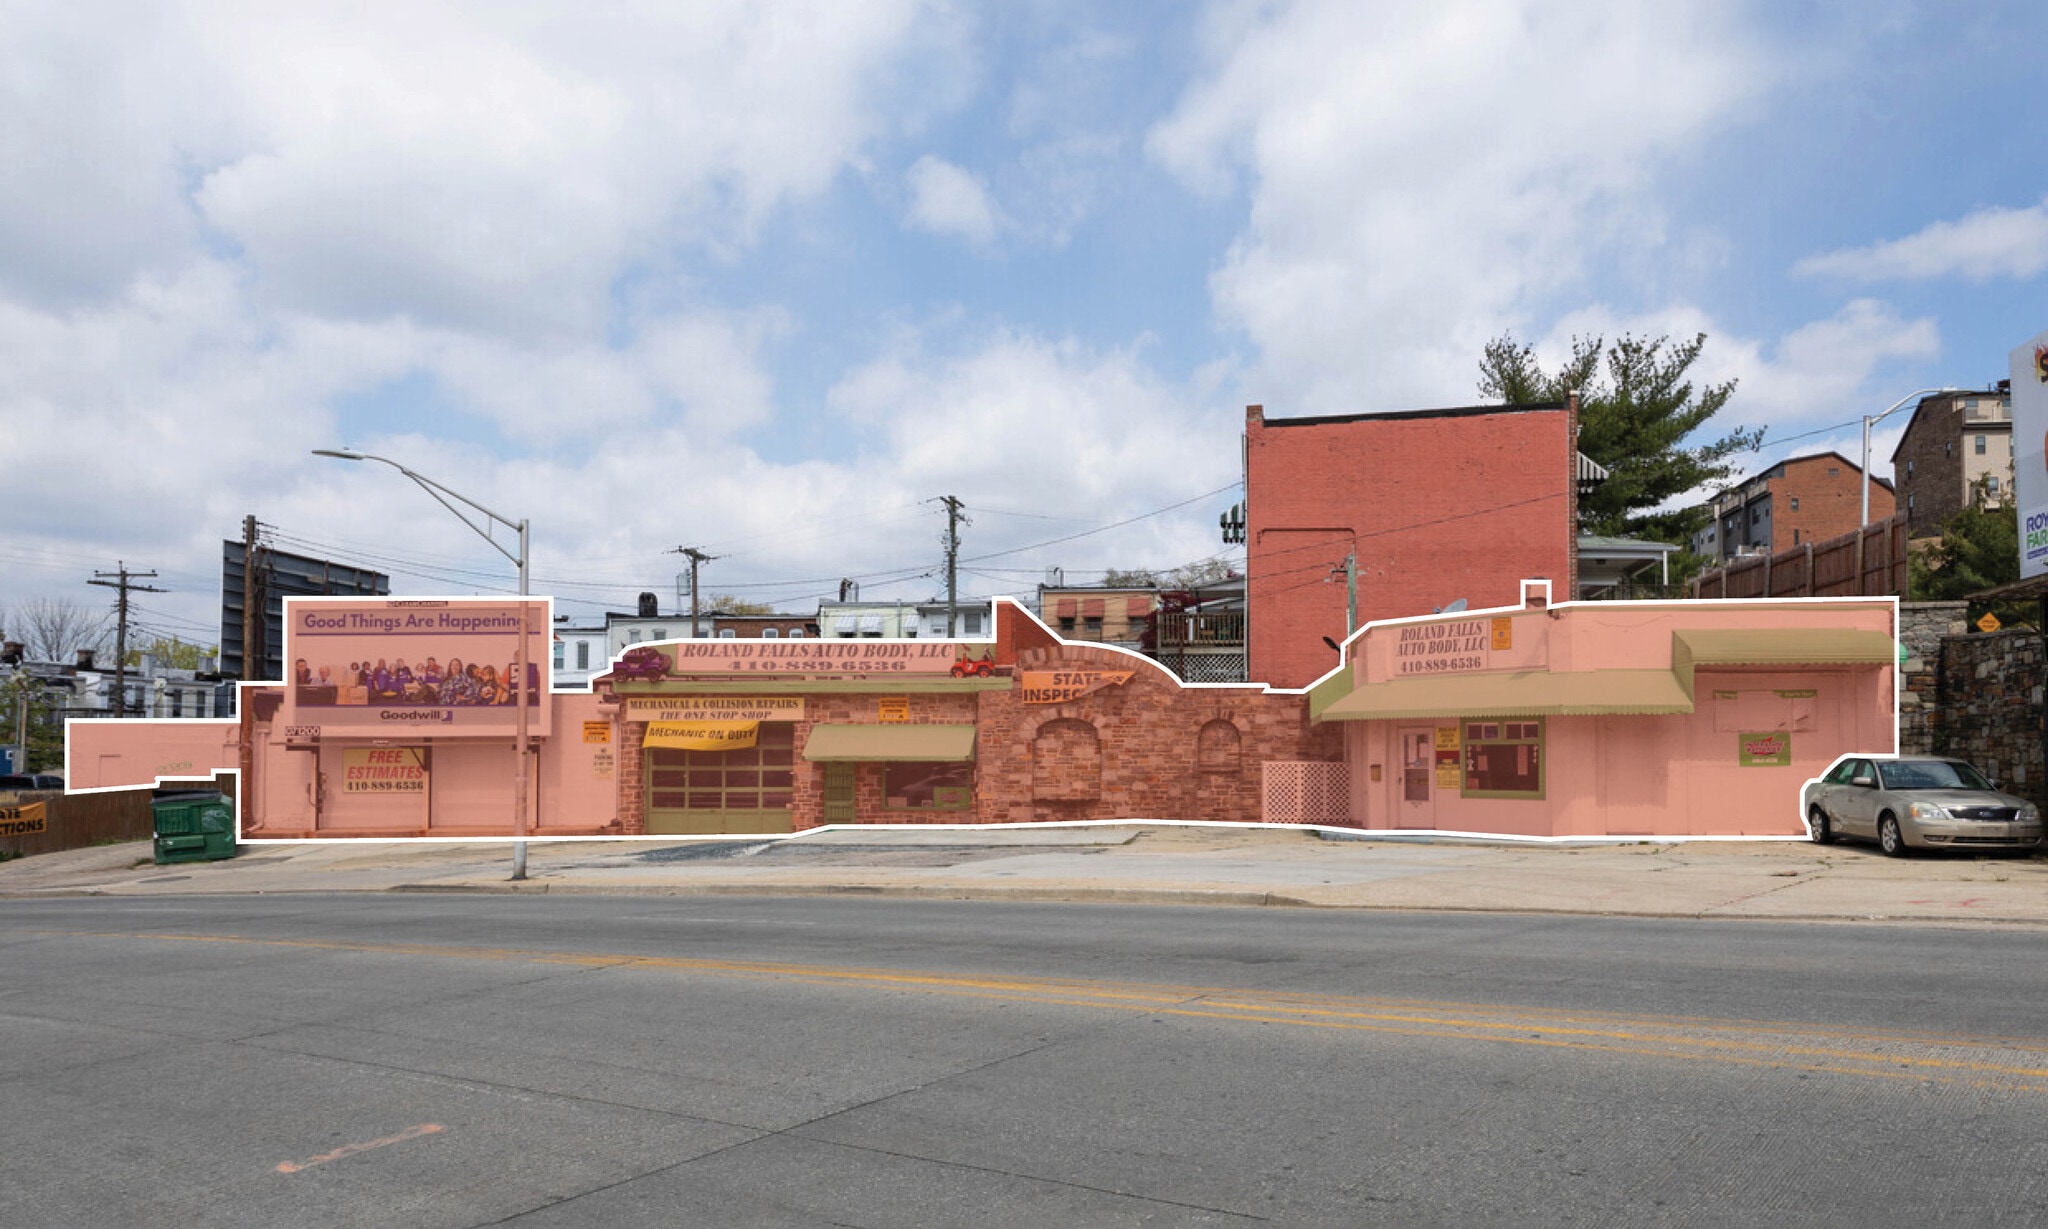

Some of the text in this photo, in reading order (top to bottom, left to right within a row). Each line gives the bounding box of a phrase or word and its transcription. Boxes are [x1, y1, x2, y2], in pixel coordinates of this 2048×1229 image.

[304, 613, 347, 628] Good
[349, 613, 401, 632] Things
[405, 613, 434, 628] Are
[1400, 624, 1446, 642] ROLAND
[1447, 621, 1484, 638] FALLS
[683, 644, 952, 660] ROLAND FALLS AUTO BODY, LLC
[1396, 636, 1488, 657] AUTO BODY, LLC
[727, 660, 907, 671] 410-889-6536
[1400, 656, 1481, 673] 410-889-6536
[1023, 688, 1084, 702] INSPEC
[630, 699, 799, 710] MECHANICAL & COLLISION REPAIRS
[380, 710, 441, 721] Goodwill
[660, 711, 772, 720] THE ONE STOP SHOP
[648, 727, 755, 741] MECHANIC ON DUTY
[368, 750, 403, 764] FREE
[347, 765, 424, 780] ESTIMATES
[347, 781, 424, 791] 410-889-6536
